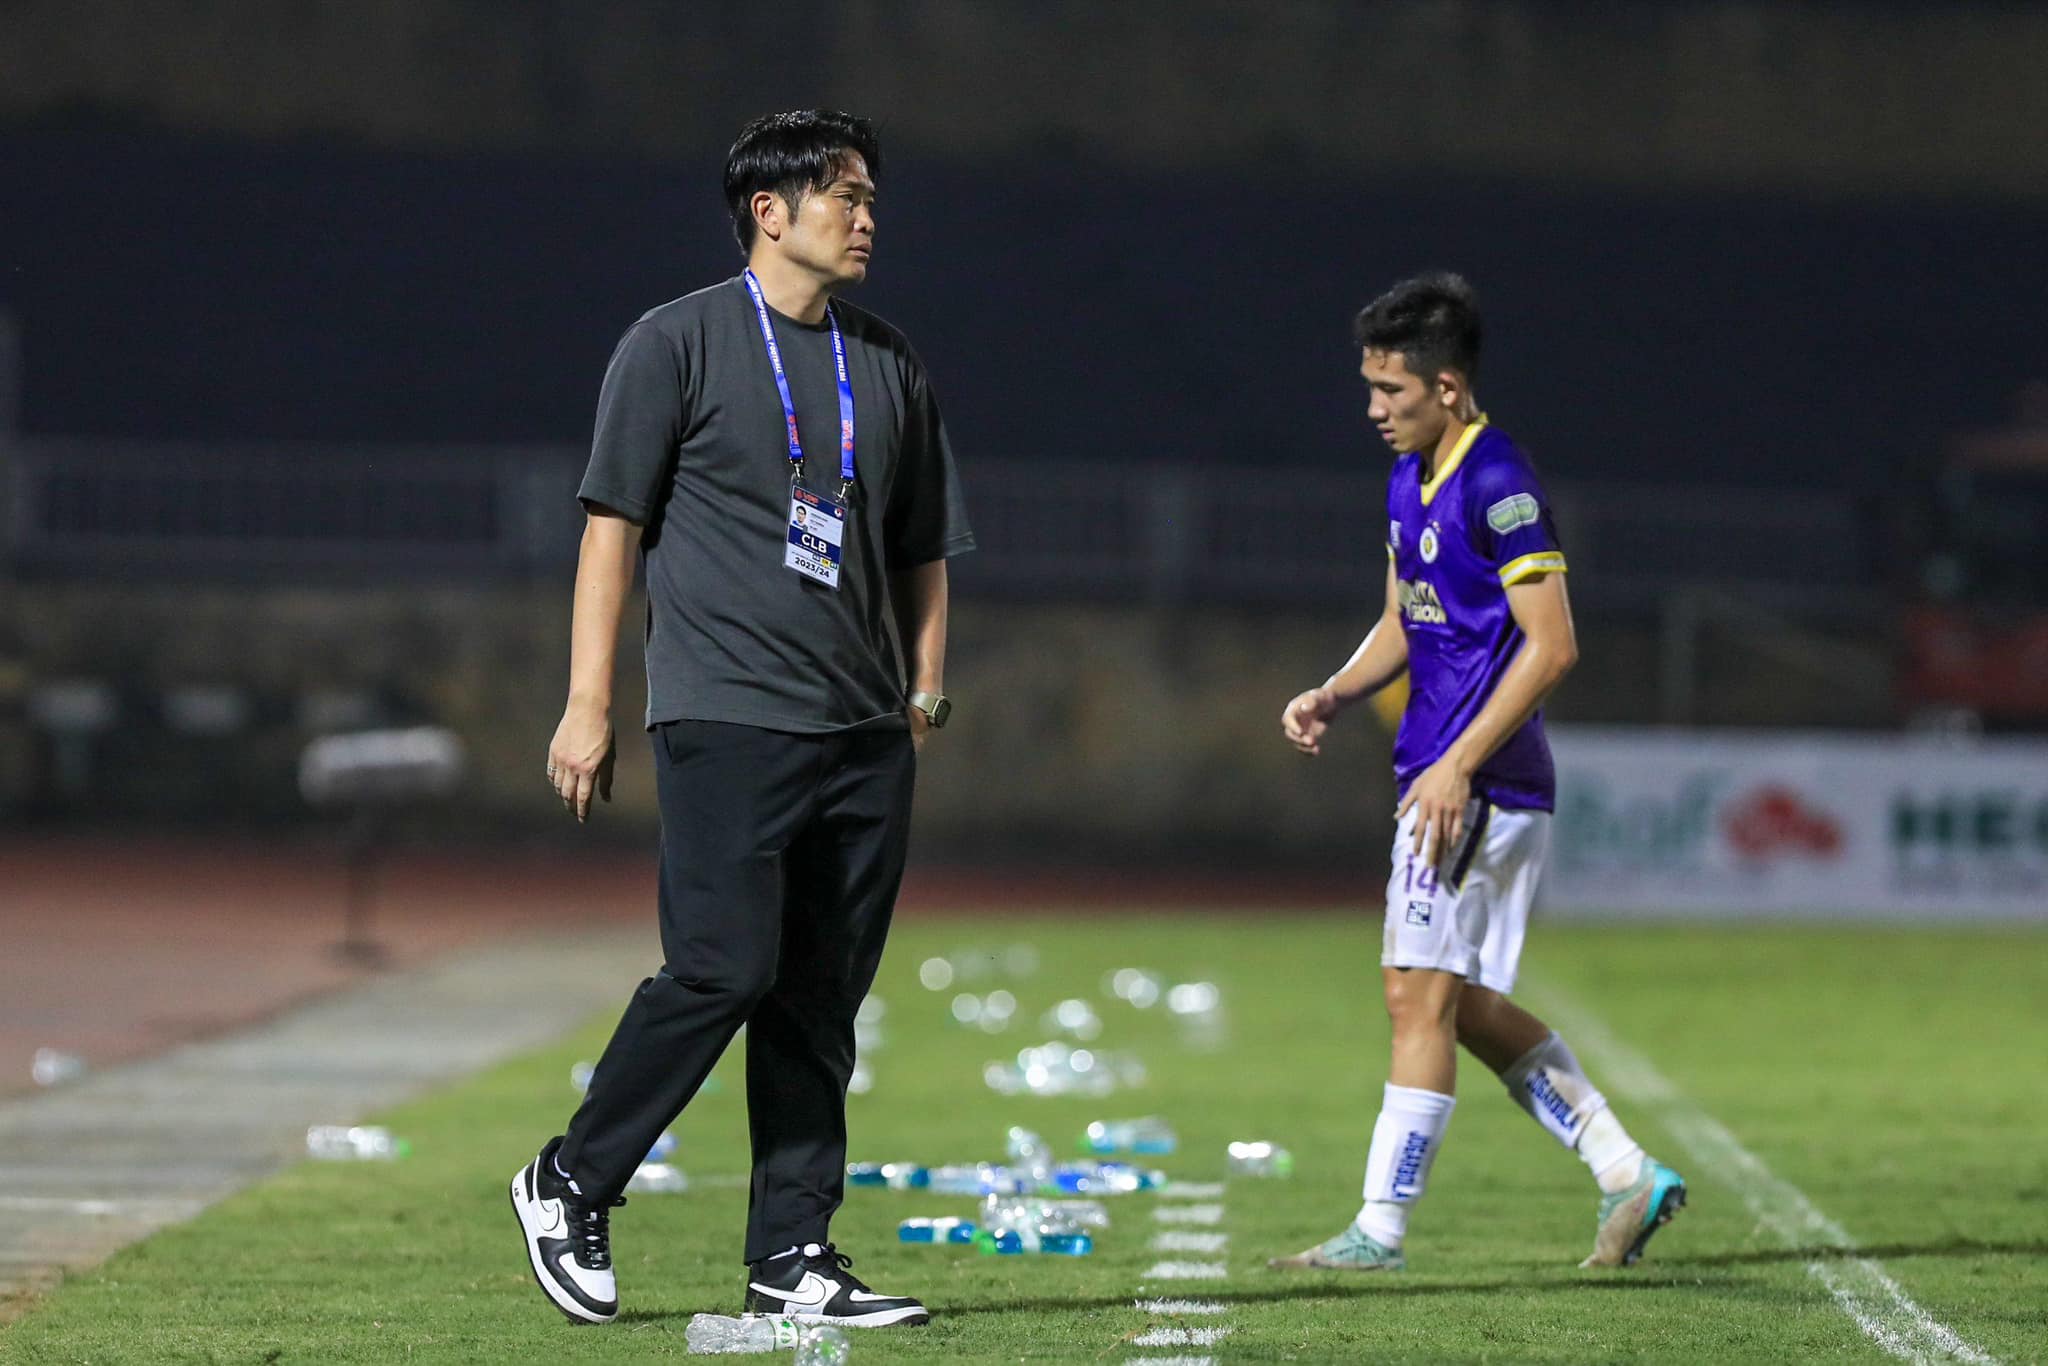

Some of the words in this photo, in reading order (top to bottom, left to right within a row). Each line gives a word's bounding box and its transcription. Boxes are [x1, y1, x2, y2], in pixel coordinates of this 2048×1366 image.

[801, 533, 828, 554] CLB
[794, 556, 830, 578] 2023/24
[1404, 853, 1439, 898] 14
